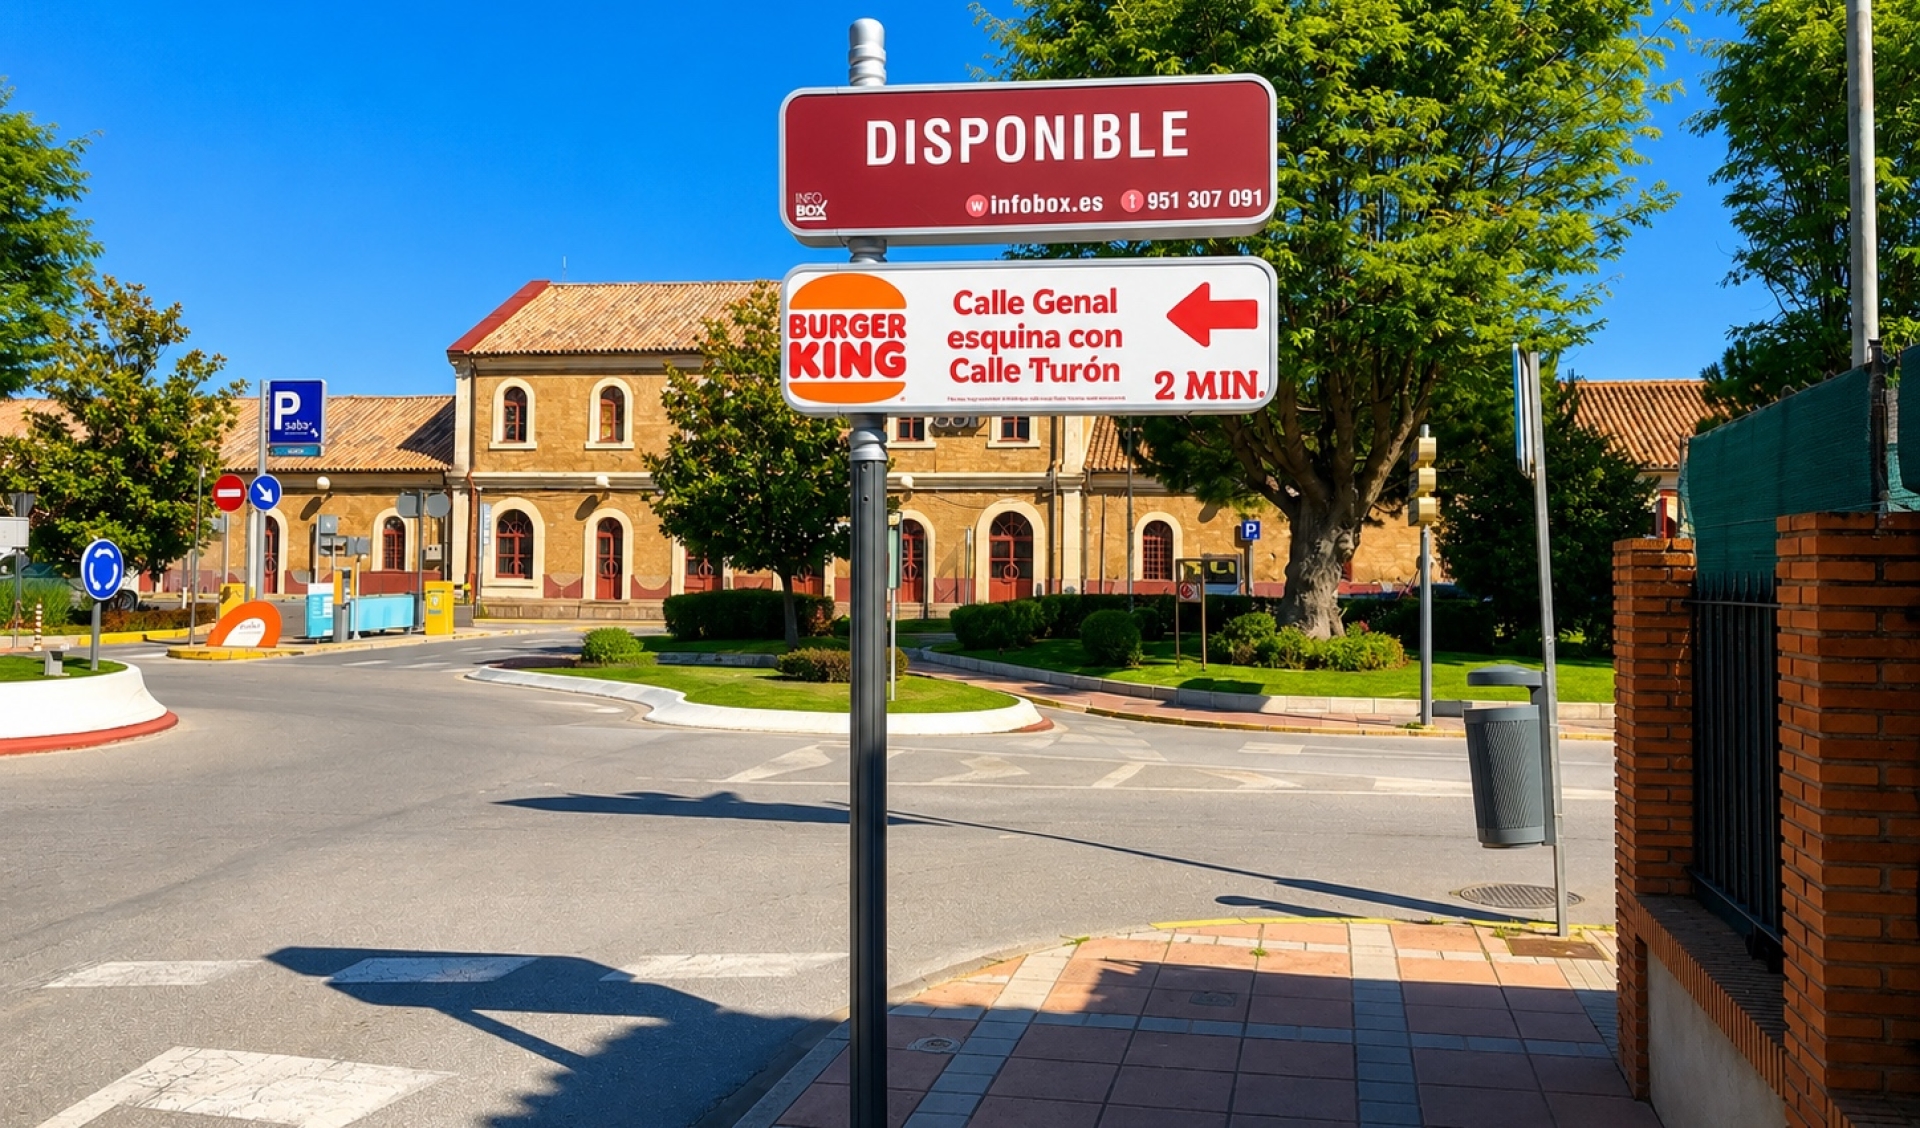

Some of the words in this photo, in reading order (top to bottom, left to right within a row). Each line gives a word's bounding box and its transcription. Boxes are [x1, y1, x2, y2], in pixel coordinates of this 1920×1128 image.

[866, 110, 1190, 166] DISPONIBLE
[796, 200, 827, 217] BOX
[991, 193, 1103, 215] infobox.es
[1147, 191, 1179, 210] 951
[1187, 190, 1222, 209] 307
[1228, 188, 1263, 208] 091
[953, 289, 1025, 316] Calle
[1032, 287, 1118, 315] Genal
[788, 312, 907, 340] BURGER
[946, 322, 1061, 357] esquina
[1068, 328, 1123, 349] con
[788, 340, 907, 380] KING
[949, 356, 1022, 384] Calle
[1028, 355, 1121, 383] Turón
[1154, 370, 1176, 401] 2
[1184, 369, 1266, 401] MIN.
[274, 391, 301, 430] P
[1245, 523, 1257, 538] P
